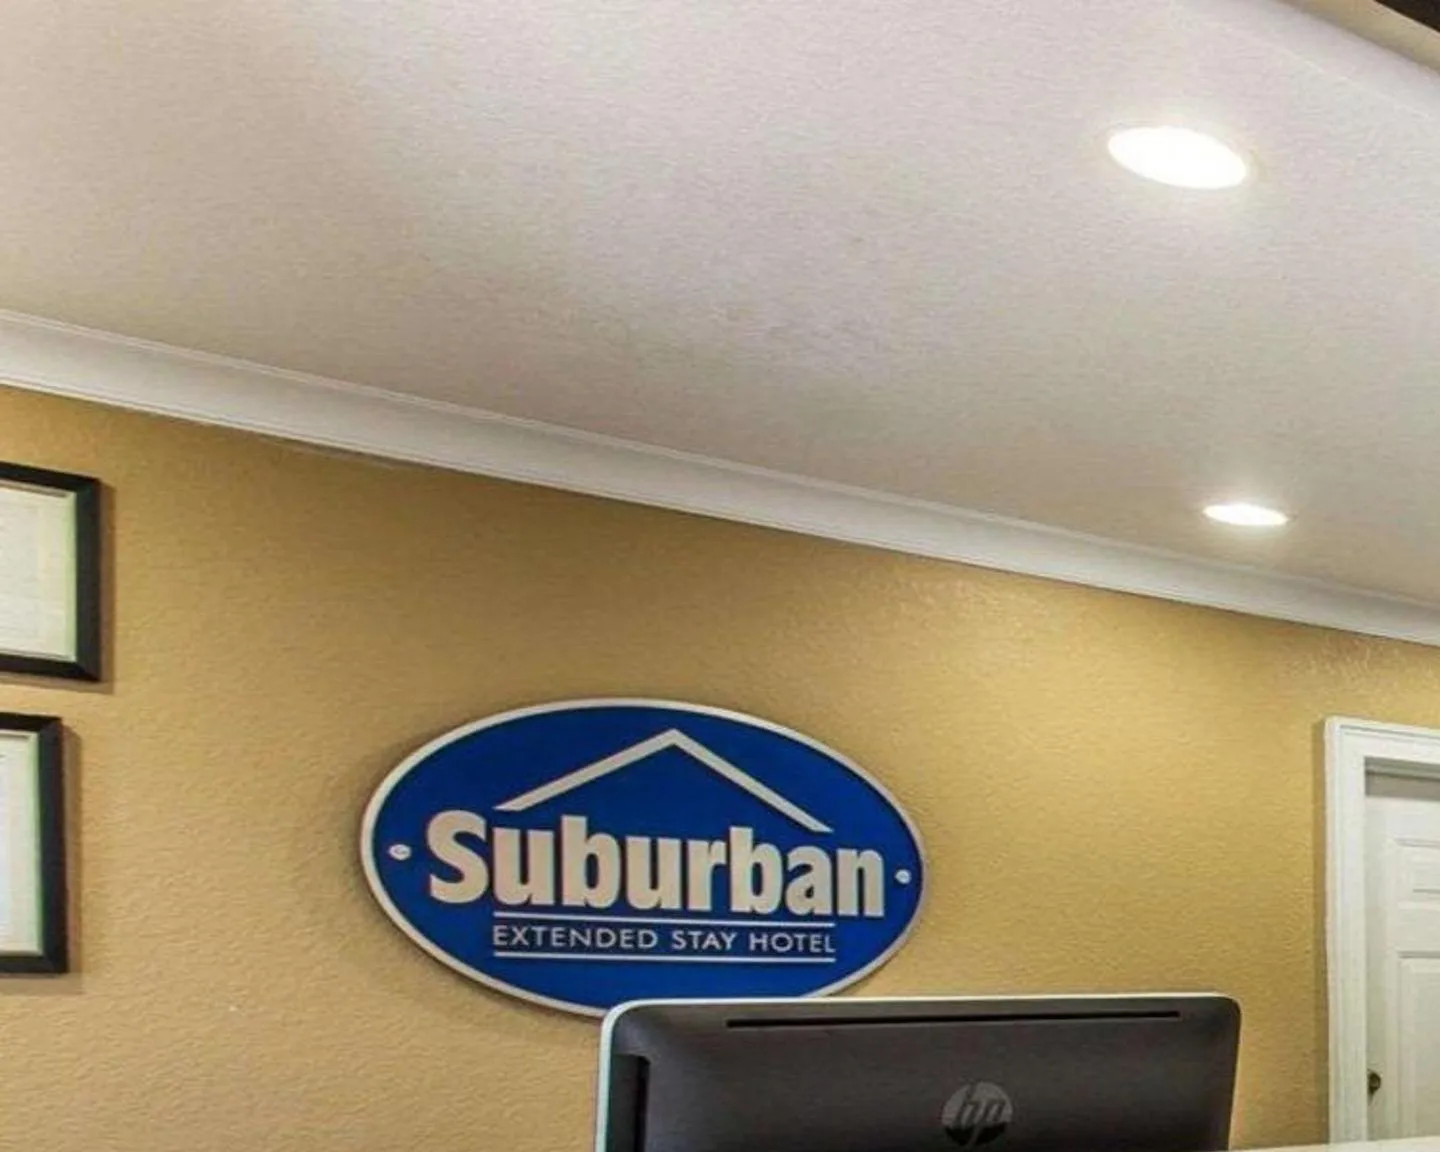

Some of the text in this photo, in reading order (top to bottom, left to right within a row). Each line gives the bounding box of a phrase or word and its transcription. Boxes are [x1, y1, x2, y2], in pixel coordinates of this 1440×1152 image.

[425, 809, 885, 918] Suburban
[493, 924, 836, 954] EXTENDED STAY HOTEL
[953, 1080, 1006, 1149] hp
